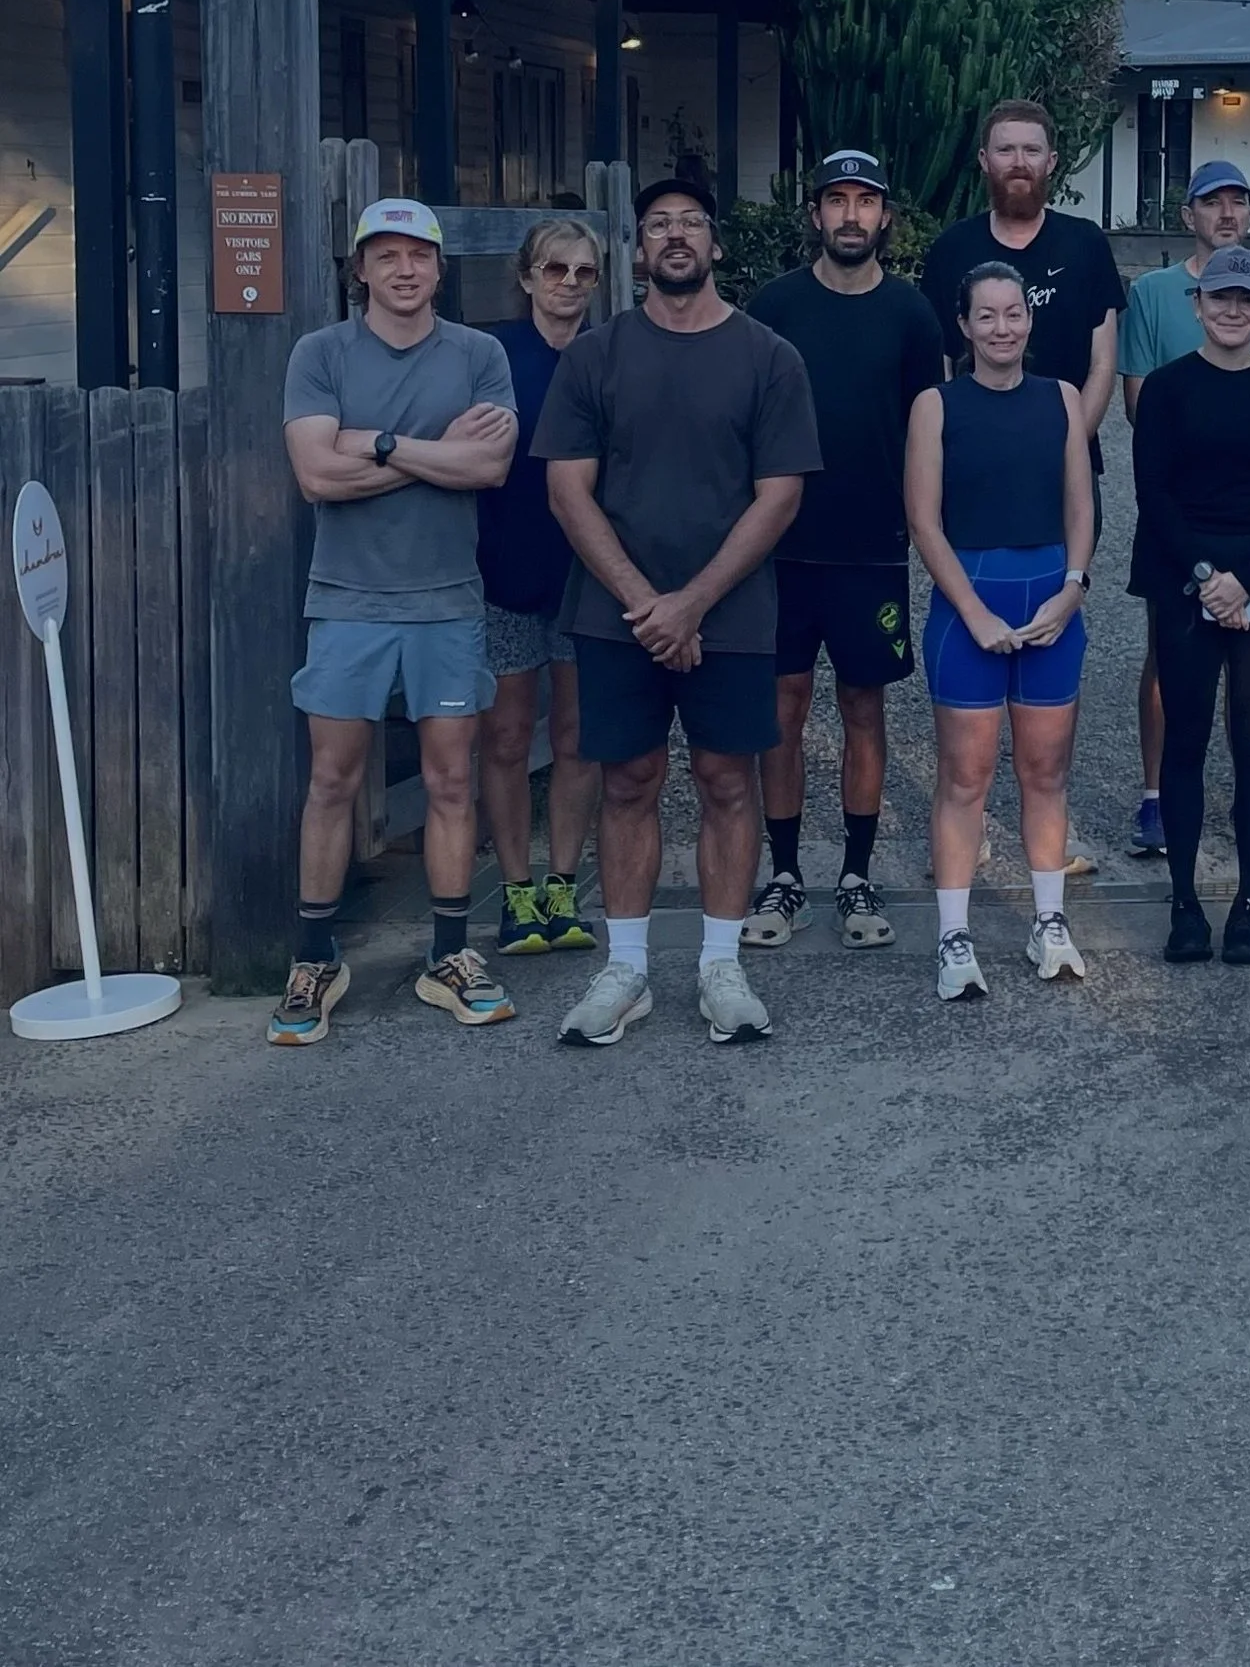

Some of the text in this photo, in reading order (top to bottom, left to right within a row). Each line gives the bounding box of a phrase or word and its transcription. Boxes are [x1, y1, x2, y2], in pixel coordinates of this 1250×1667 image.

[221, 212, 274, 224] NO ENTRY
[225, 237, 270, 248] VISITORS
[235, 251, 262, 262] CARS
[235, 265, 262, 275] ONLY
